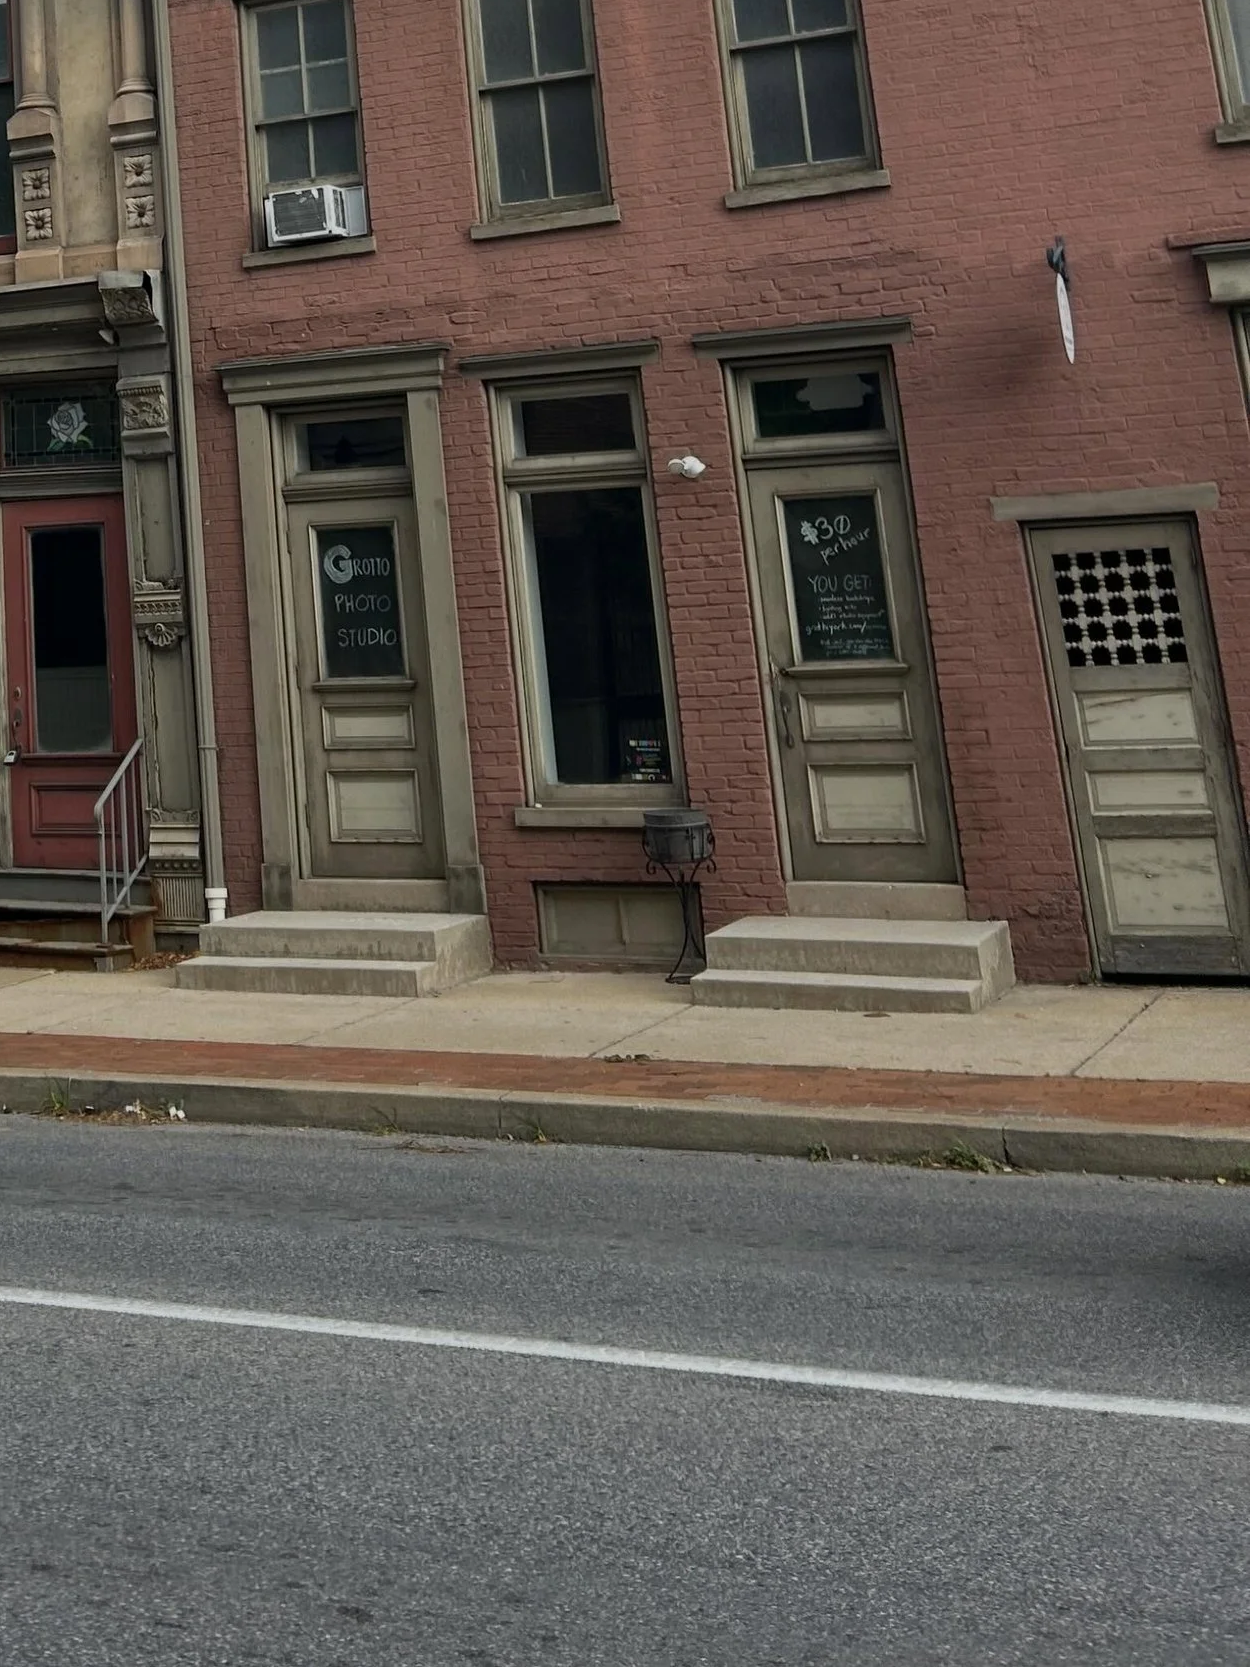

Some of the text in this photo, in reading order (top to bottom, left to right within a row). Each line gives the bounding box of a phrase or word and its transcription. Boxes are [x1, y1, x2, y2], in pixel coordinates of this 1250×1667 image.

[800, 514, 851, 545] $30
[820, 527, 871, 566] per hour
[807, 575, 838, 594] YOU
[335, 593, 391, 613] PHOTO
[338, 627, 397, 647] STUDIO
